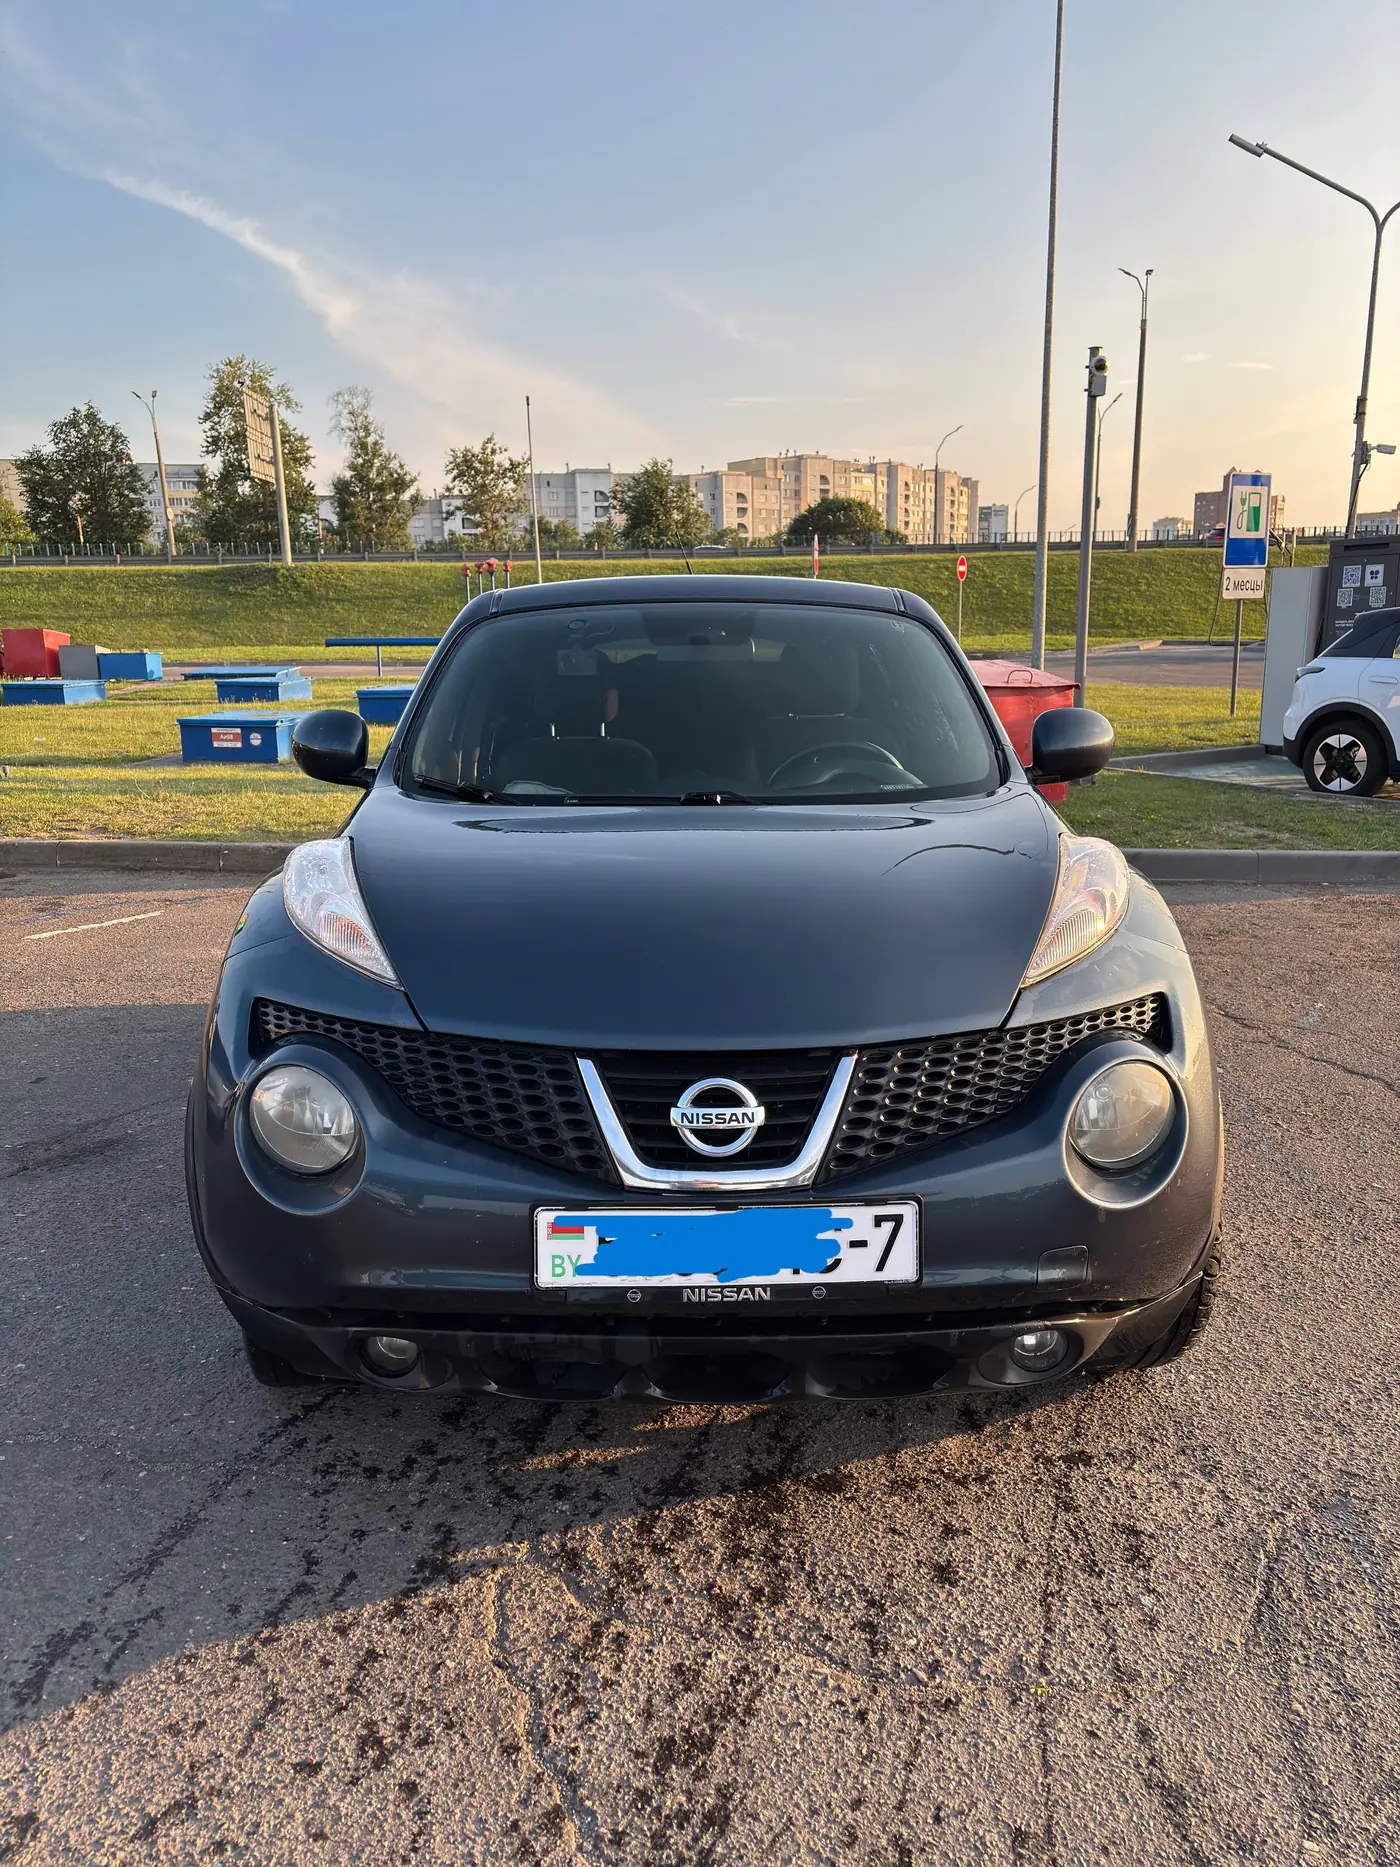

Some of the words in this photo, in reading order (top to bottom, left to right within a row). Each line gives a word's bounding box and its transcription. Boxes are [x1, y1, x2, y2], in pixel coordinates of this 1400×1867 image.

[1225, 576, 1230, 591] 2
[1233, 579, 1263, 593] месцы
[680, 1112, 755, 1125] NISSAN
[551, 1254, 582, 1278] BY
[682, 1287, 771, 1303] NISSAN
